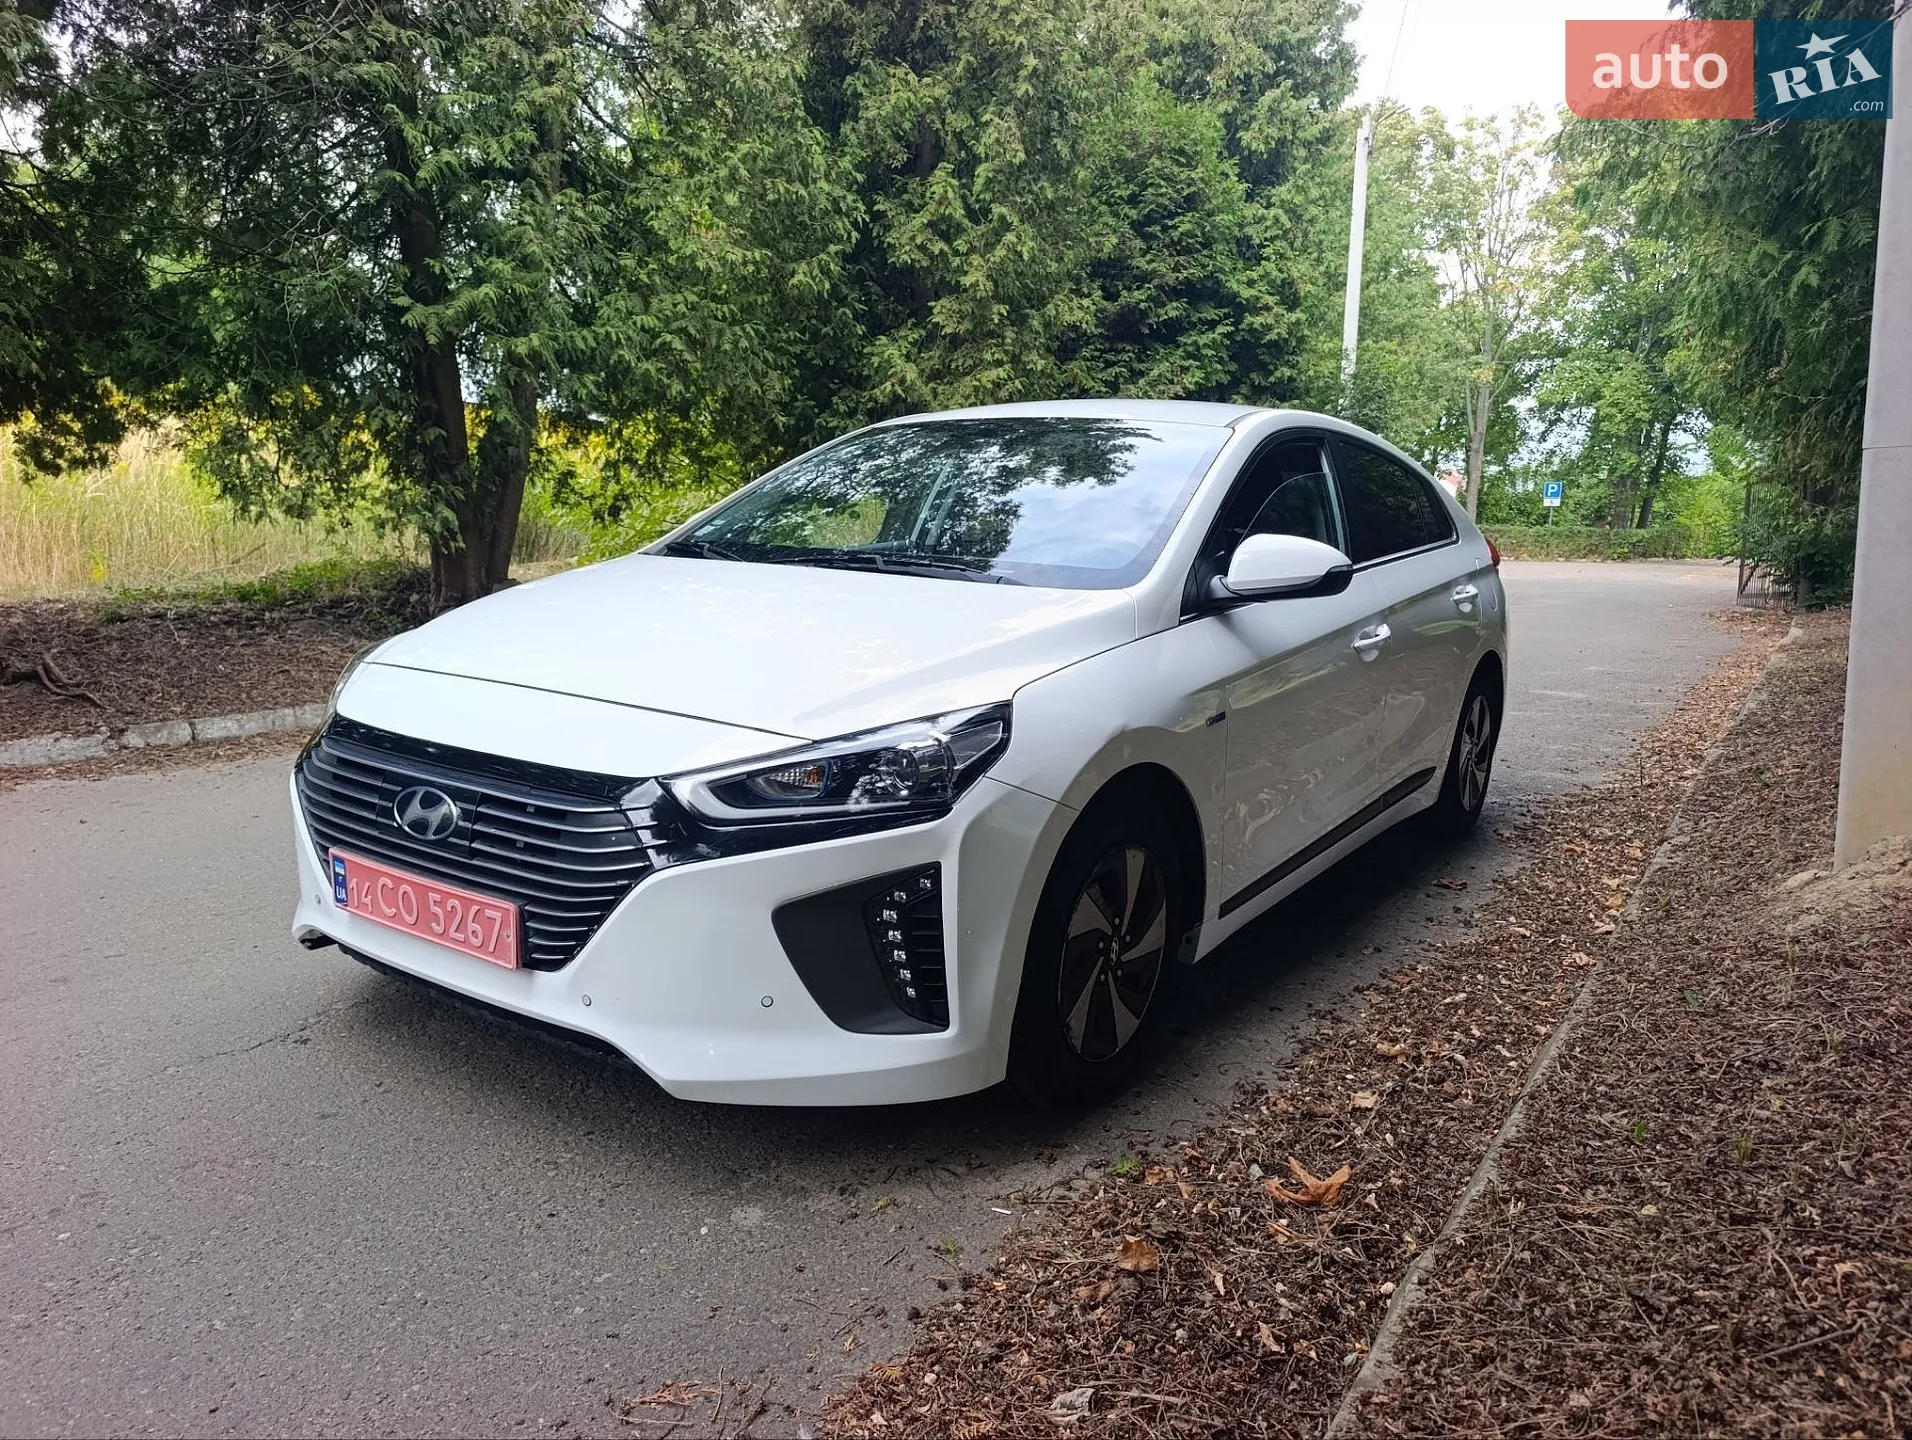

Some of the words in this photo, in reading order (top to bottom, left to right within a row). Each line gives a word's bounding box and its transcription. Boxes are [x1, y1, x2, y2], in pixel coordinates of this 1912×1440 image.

[1547, 483, 1558, 497] P
[336, 885, 347, 901] UA
[428, 891, 502, 953] 5267
